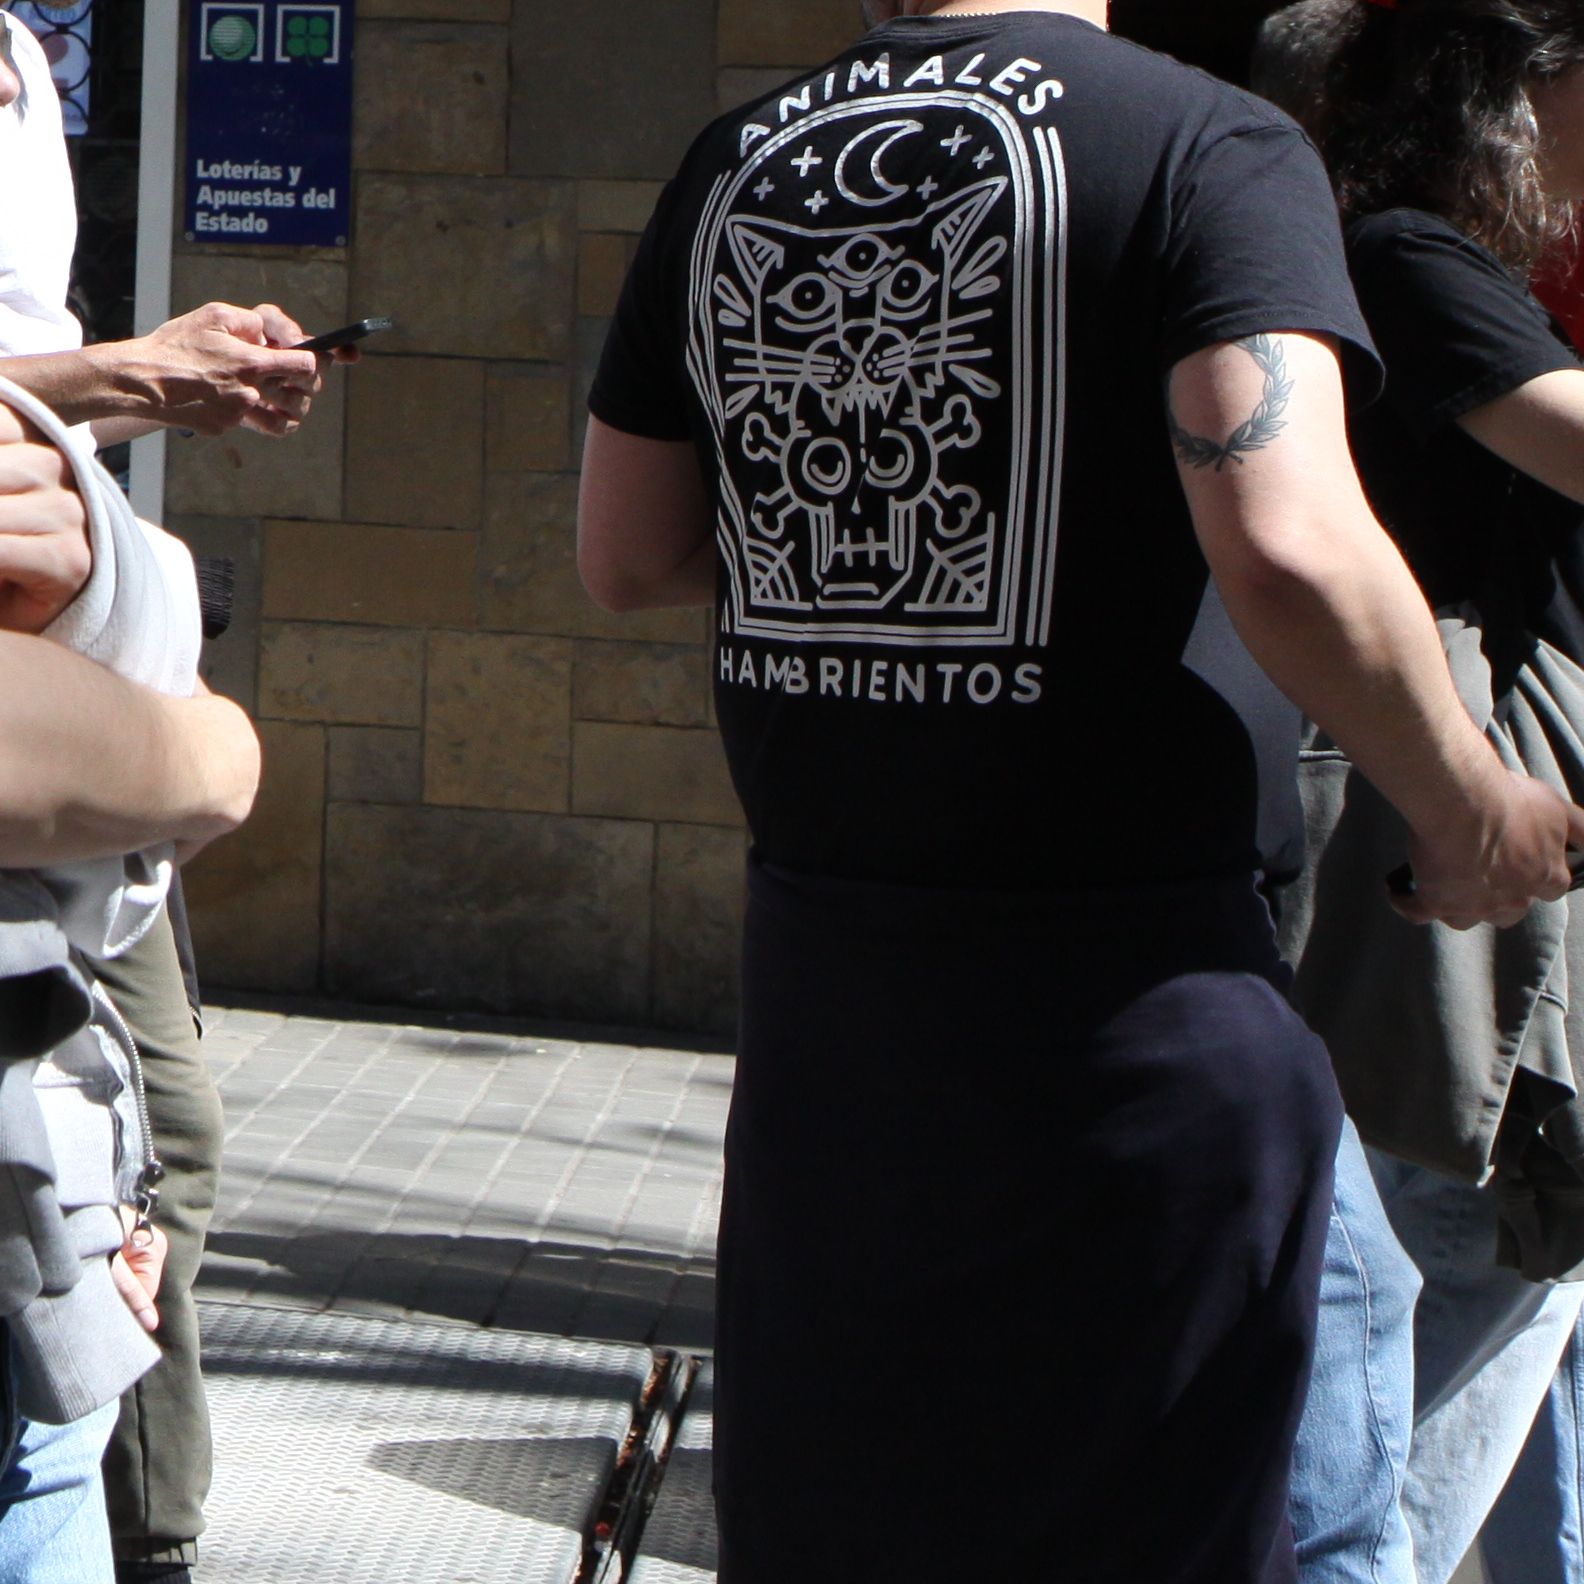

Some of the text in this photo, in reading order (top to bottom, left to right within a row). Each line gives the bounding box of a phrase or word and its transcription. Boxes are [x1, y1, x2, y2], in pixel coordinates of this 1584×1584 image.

[738, 53, 1066, 158] ANIMALES
[196, 158, 302, 186] Loterías y
[196, 185, 337, 210] Apuestas del
[195, 211, 269, 234] Estado
[718, 644, 1043, 704] HAMBRIENTOS
